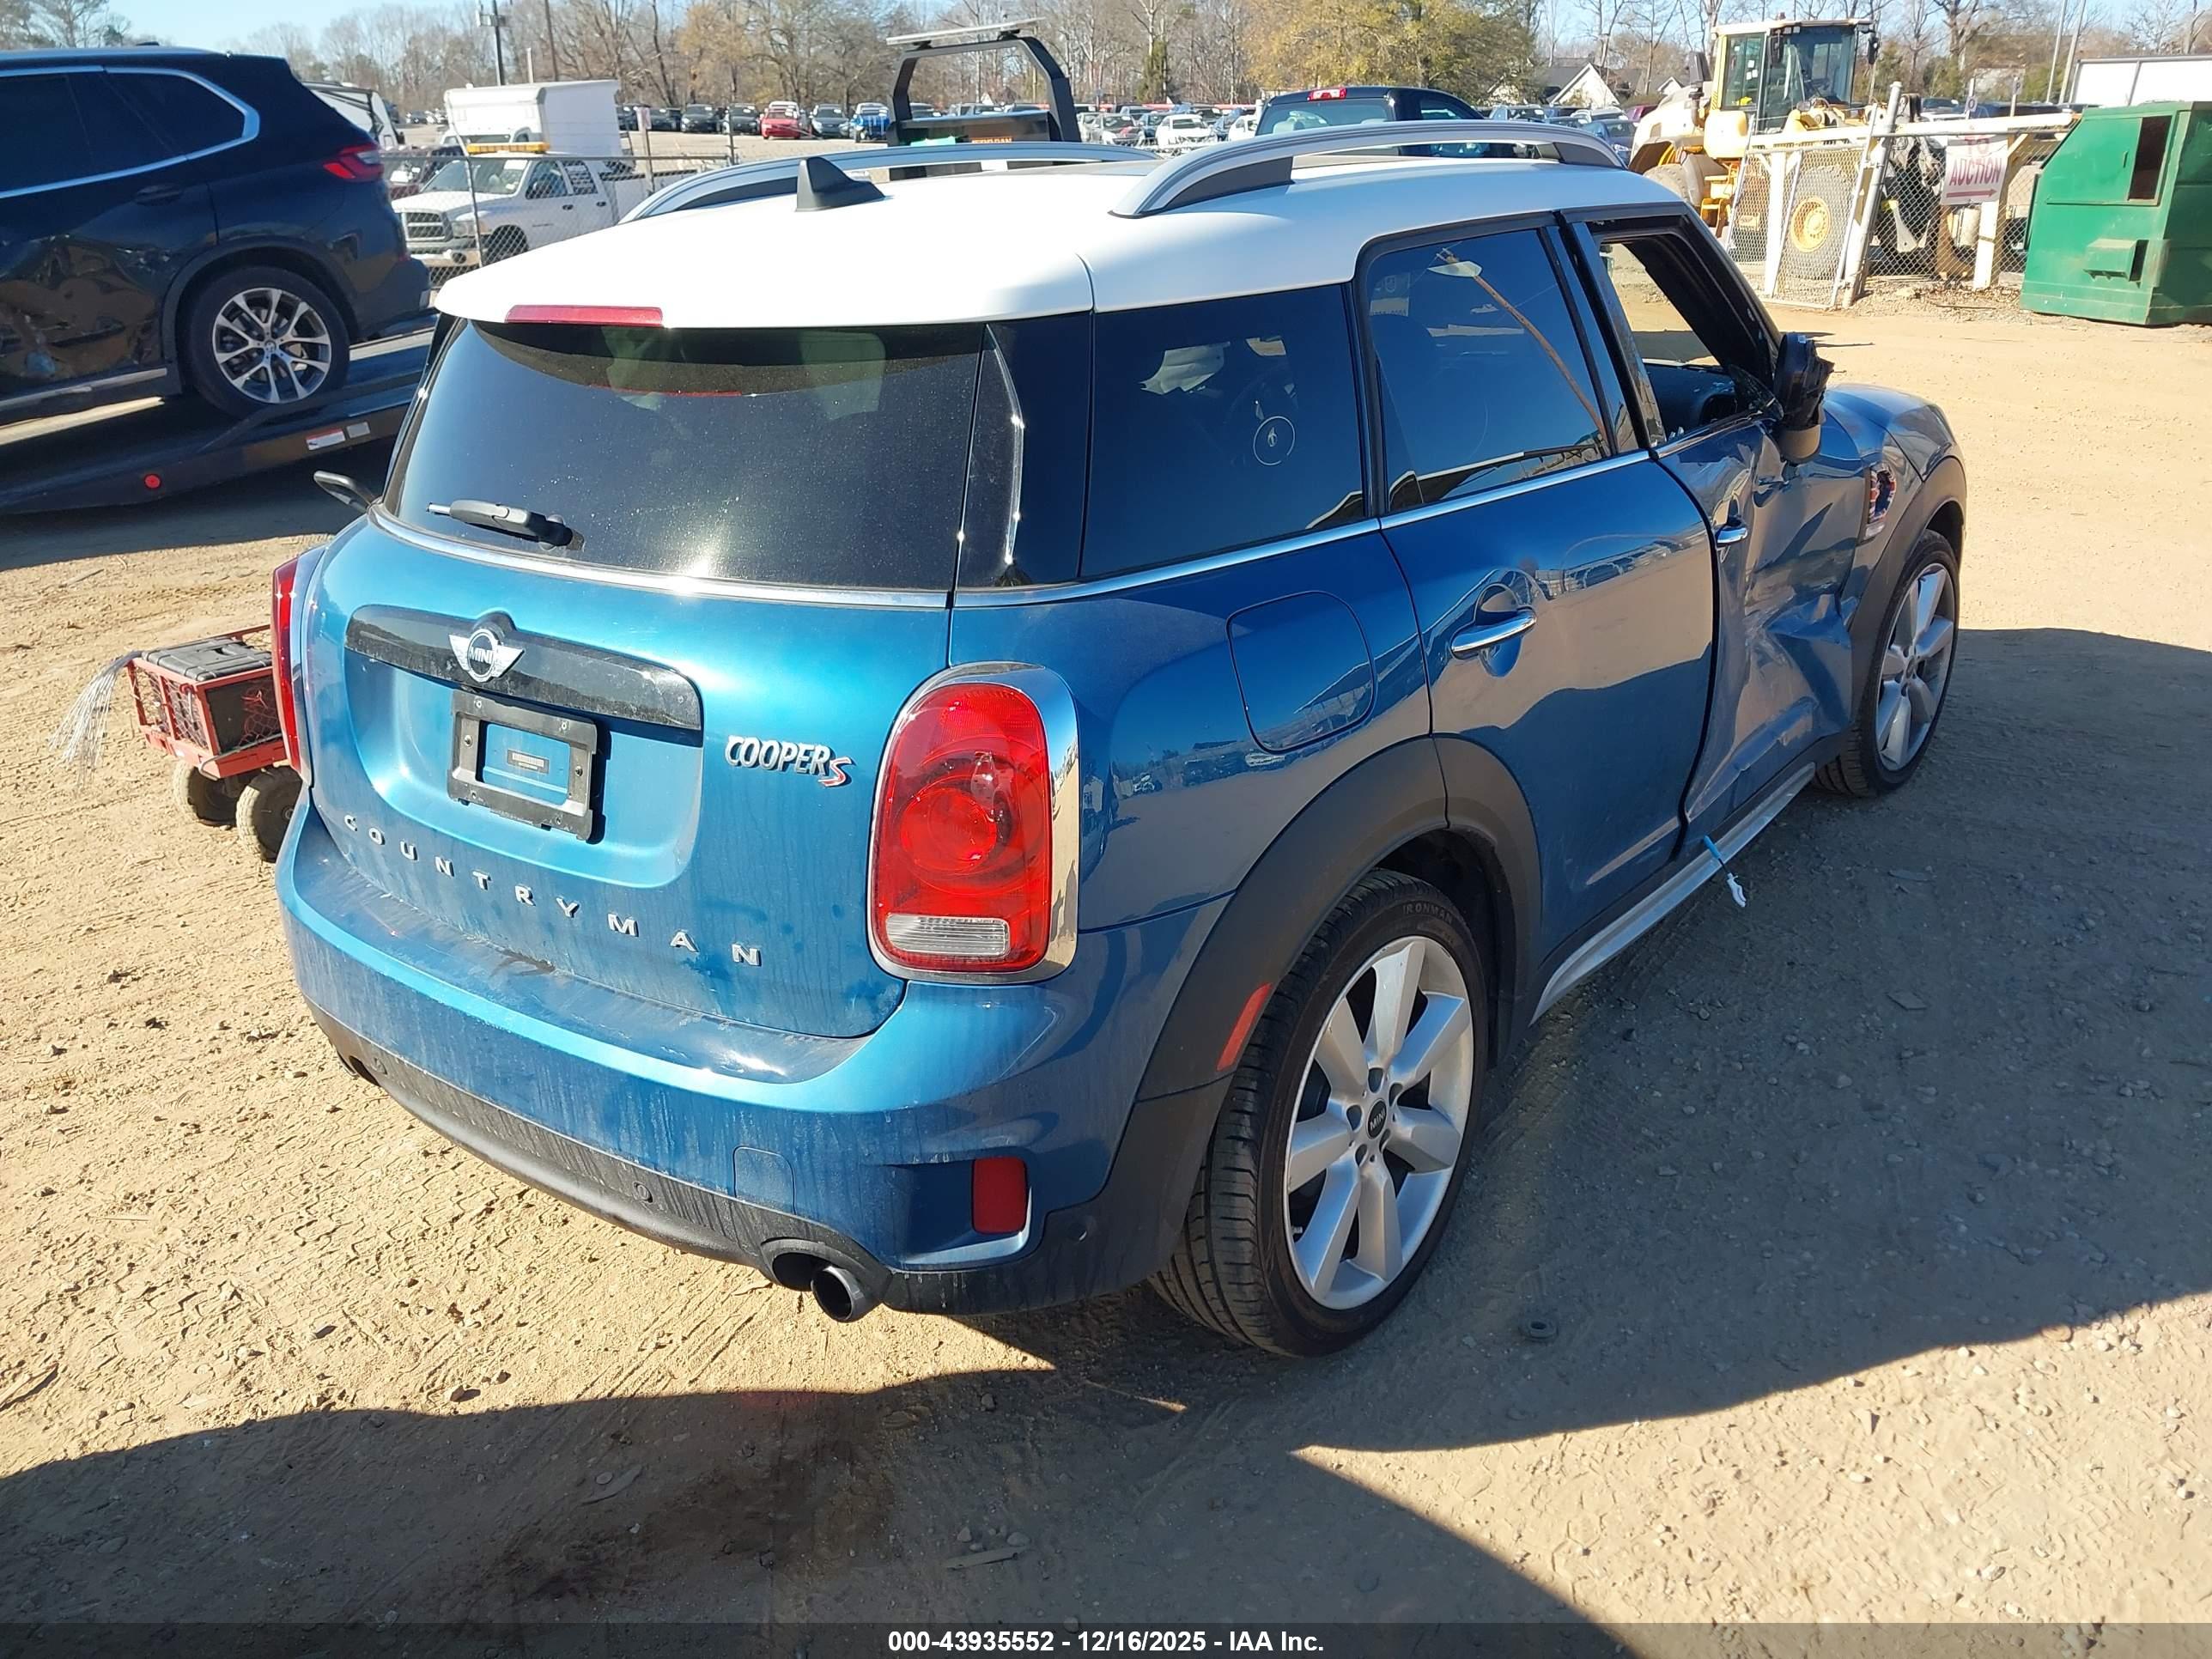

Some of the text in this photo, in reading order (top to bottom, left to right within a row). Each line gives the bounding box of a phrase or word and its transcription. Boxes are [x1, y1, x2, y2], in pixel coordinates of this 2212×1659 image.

[1964, 135, 1990, 155] TO
[1948, 157, 2002, 186] AUCTION
[469, 646, 494, 665] MINI
[343, 814, 762, 967] COUNTRYMAN
[1402, 902, 1454, 925] IRONMAN
[1370, 1107, 1386, 1132] MINI
